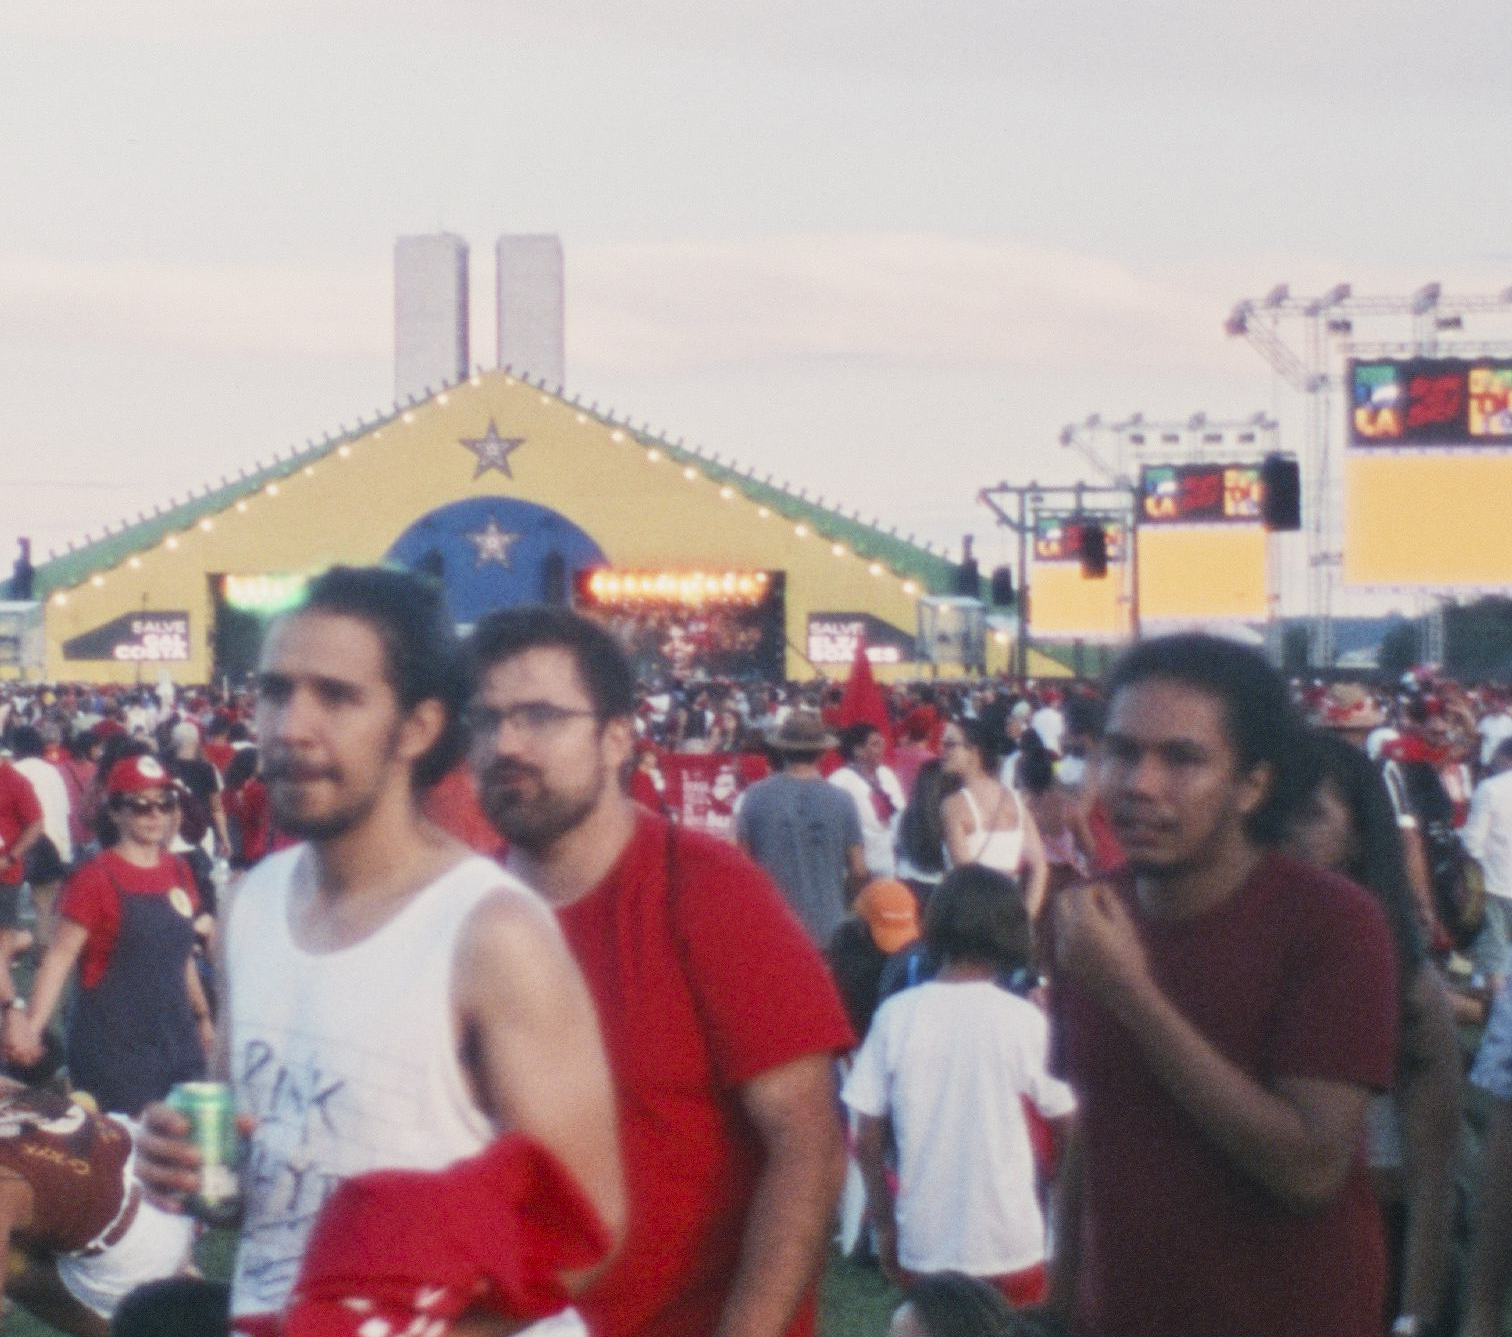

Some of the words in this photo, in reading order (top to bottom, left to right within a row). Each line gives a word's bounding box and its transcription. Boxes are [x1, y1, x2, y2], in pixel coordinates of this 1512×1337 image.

[131, 620, 187, 635] SALVE
[809, 621, 864, 636] SALVE
[113, 644, 188, 660] COSTA
[808, 646, 899, 662] SOAES
